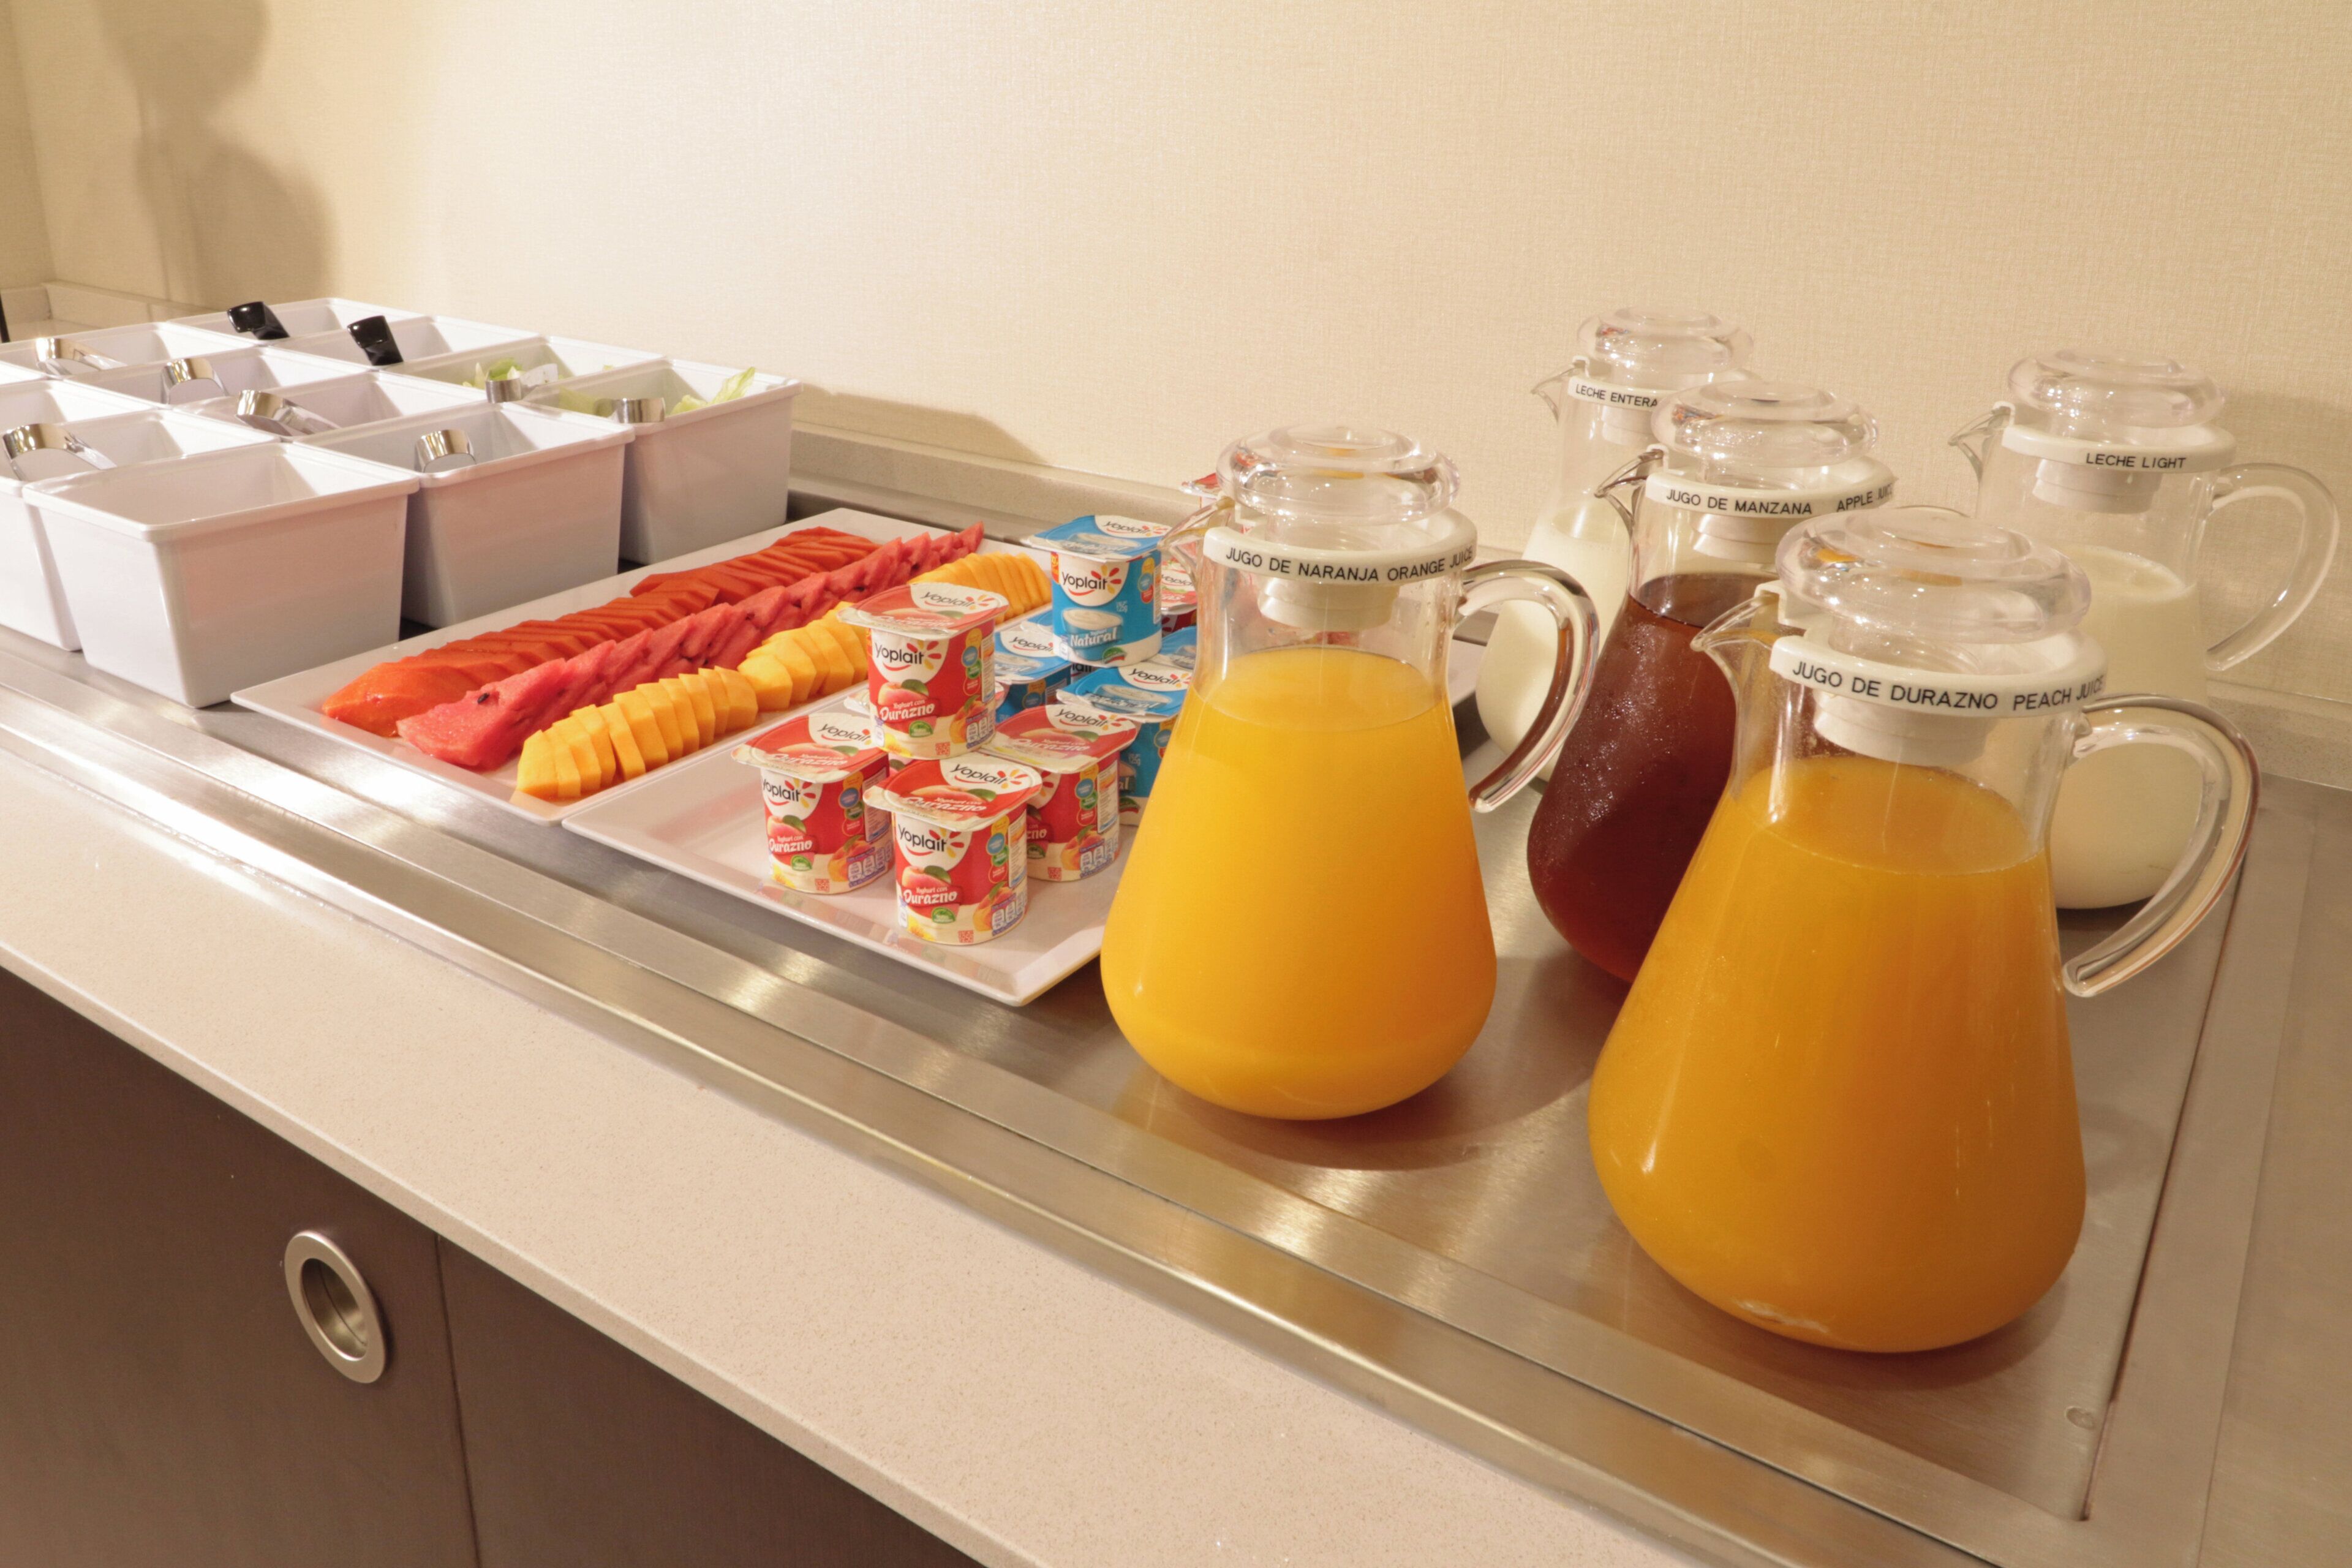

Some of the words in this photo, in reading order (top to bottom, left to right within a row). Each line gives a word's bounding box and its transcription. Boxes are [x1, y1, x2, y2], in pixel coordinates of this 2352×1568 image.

[1575, 383, 1606, 401] LECHE
[1610, 391, 1658, 409] ENTERA
[2086, 452, 2136, 469] LECHE
[2141, 456, 2187, 469] LIGHT
[1665, 488, 1702, 507] JUGO
[1707, 496, 1728, 511] DE
[1734, 500, 1812, 516] MANZANA
[1836, 491, 1874, 513] APPLE
[1226, 547, 1262, 568] JUGO
[1269, 557, 1291, 574] DE
[1298, 562, 1379, 582] NARANJA
[1387, 558, 1446, 581] ORANGE
[1061, 571, 1108, 590] Yoplait
[919, 591, 976, 608] Yoplait
[1070, 627, 1118, 647] Natural
[874, 642, 925, 665] Yoplait
[1129, 668, 1181, 685] Yoplait
[1792, 660, 1842, 688] JUGO
[1851, 677, 1881, 698] DE
[1890, 684, 1999, 710] DURAZNO
[2012, 686, 2071, 711] PEACH
[2076, 674, 2104, 701] JUICE
[880, 703, 935, 722] Durazno
[1055, 708, 1108, 728] Yoplait
[949, 764, 1008, 785] Yoplait
[769, 839, 813, 852] Durazno
[898, 824, 947, 852] Yoplait
[903, 889, 958, 905] Durazno
